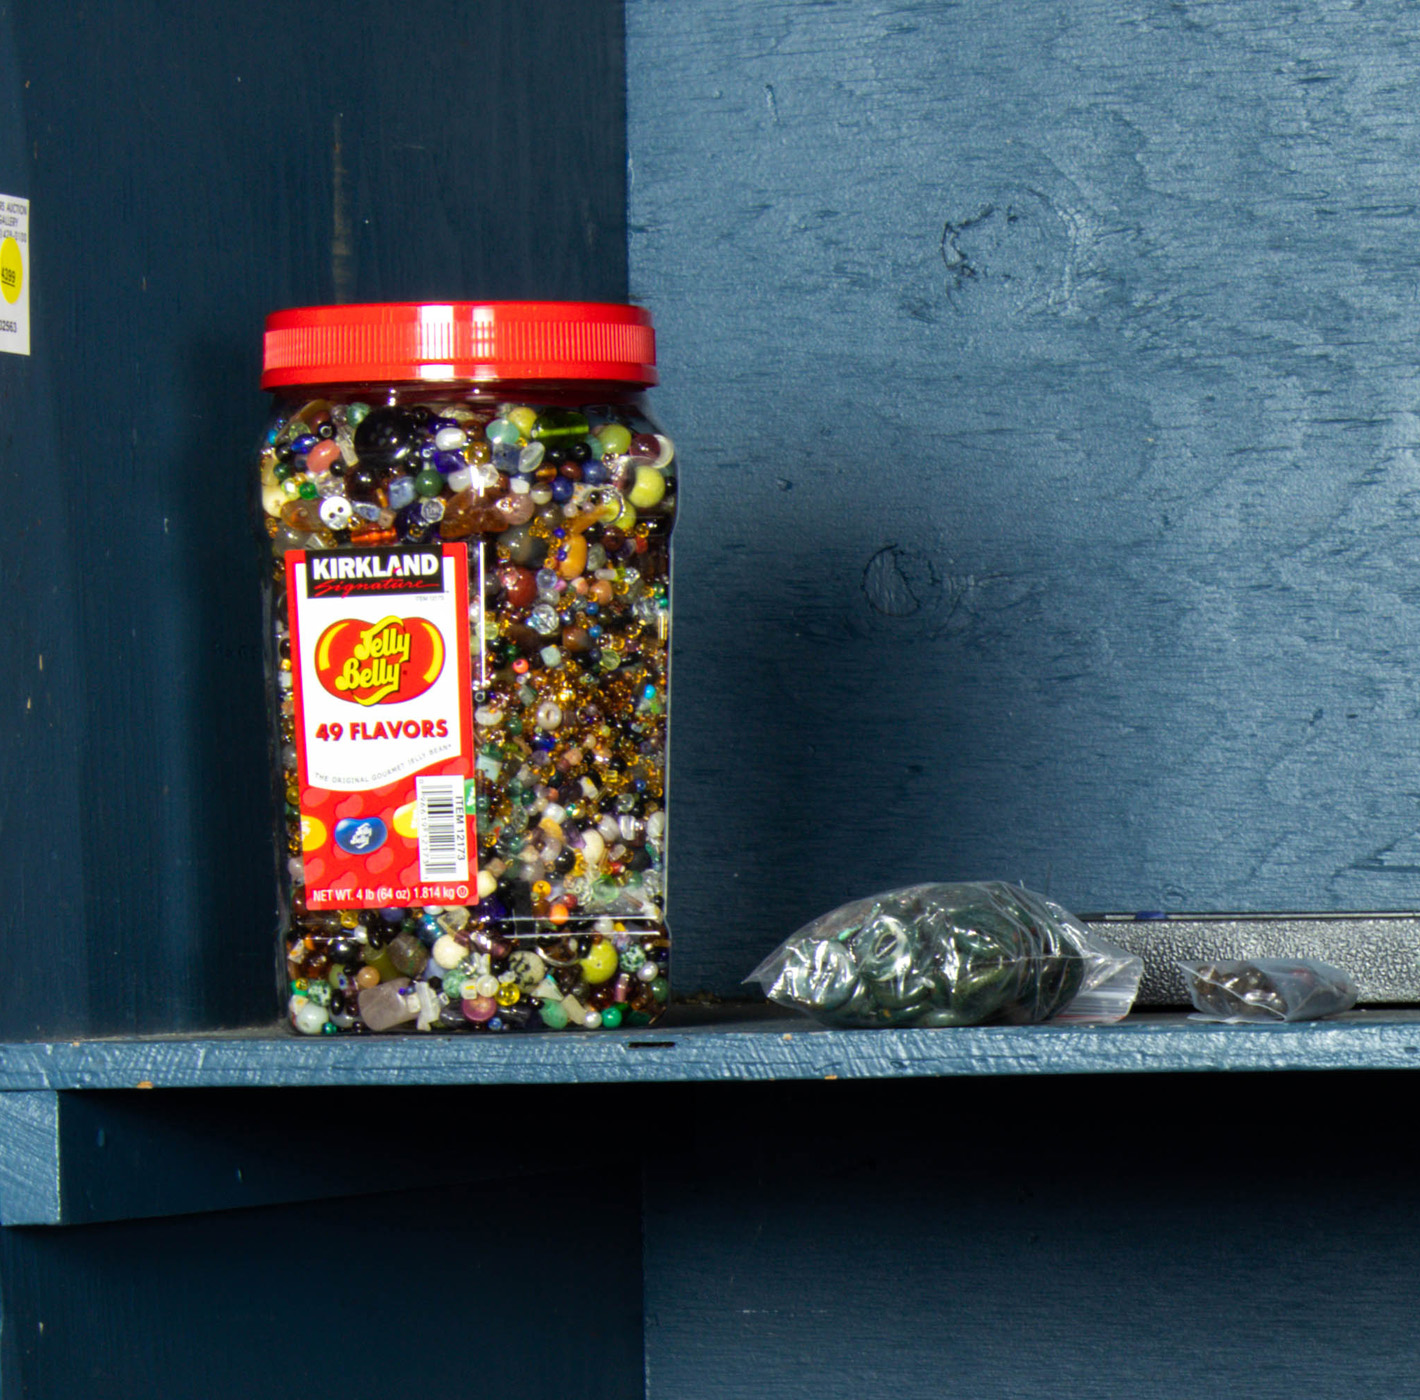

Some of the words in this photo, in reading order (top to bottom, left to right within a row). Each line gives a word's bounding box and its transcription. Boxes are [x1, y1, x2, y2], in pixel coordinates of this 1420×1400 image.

[312, 553, 440, 580] KIRKLAND
[313, 578, 440, 599] Signature
[354, 614, 410, 664] Jelly
[334, 658, 400, 707] Belly
[315, 722, 344, 742] 49
[350, 718, 448, 740] FLAVORS
[315, 772, 328, 782] THE
[332, 776, 369, 784] ORIGINAL
[372, 762, 405, 781] GOURMET
[456, 796, 464, 824] ITEM
[457, 830, 465, 860] 12173
[312, 890, 333, 902] NET
[335, 889, 354, 901] WT.
[356, 889, 362, 900] 4
[365, 888, 374, 900] lb
[377, 888, 393, 902] (64
[395, 888, 410, 900] oz)
[413, 886, 440, 899] 1.814
[443, 886, 454, 900] kg
